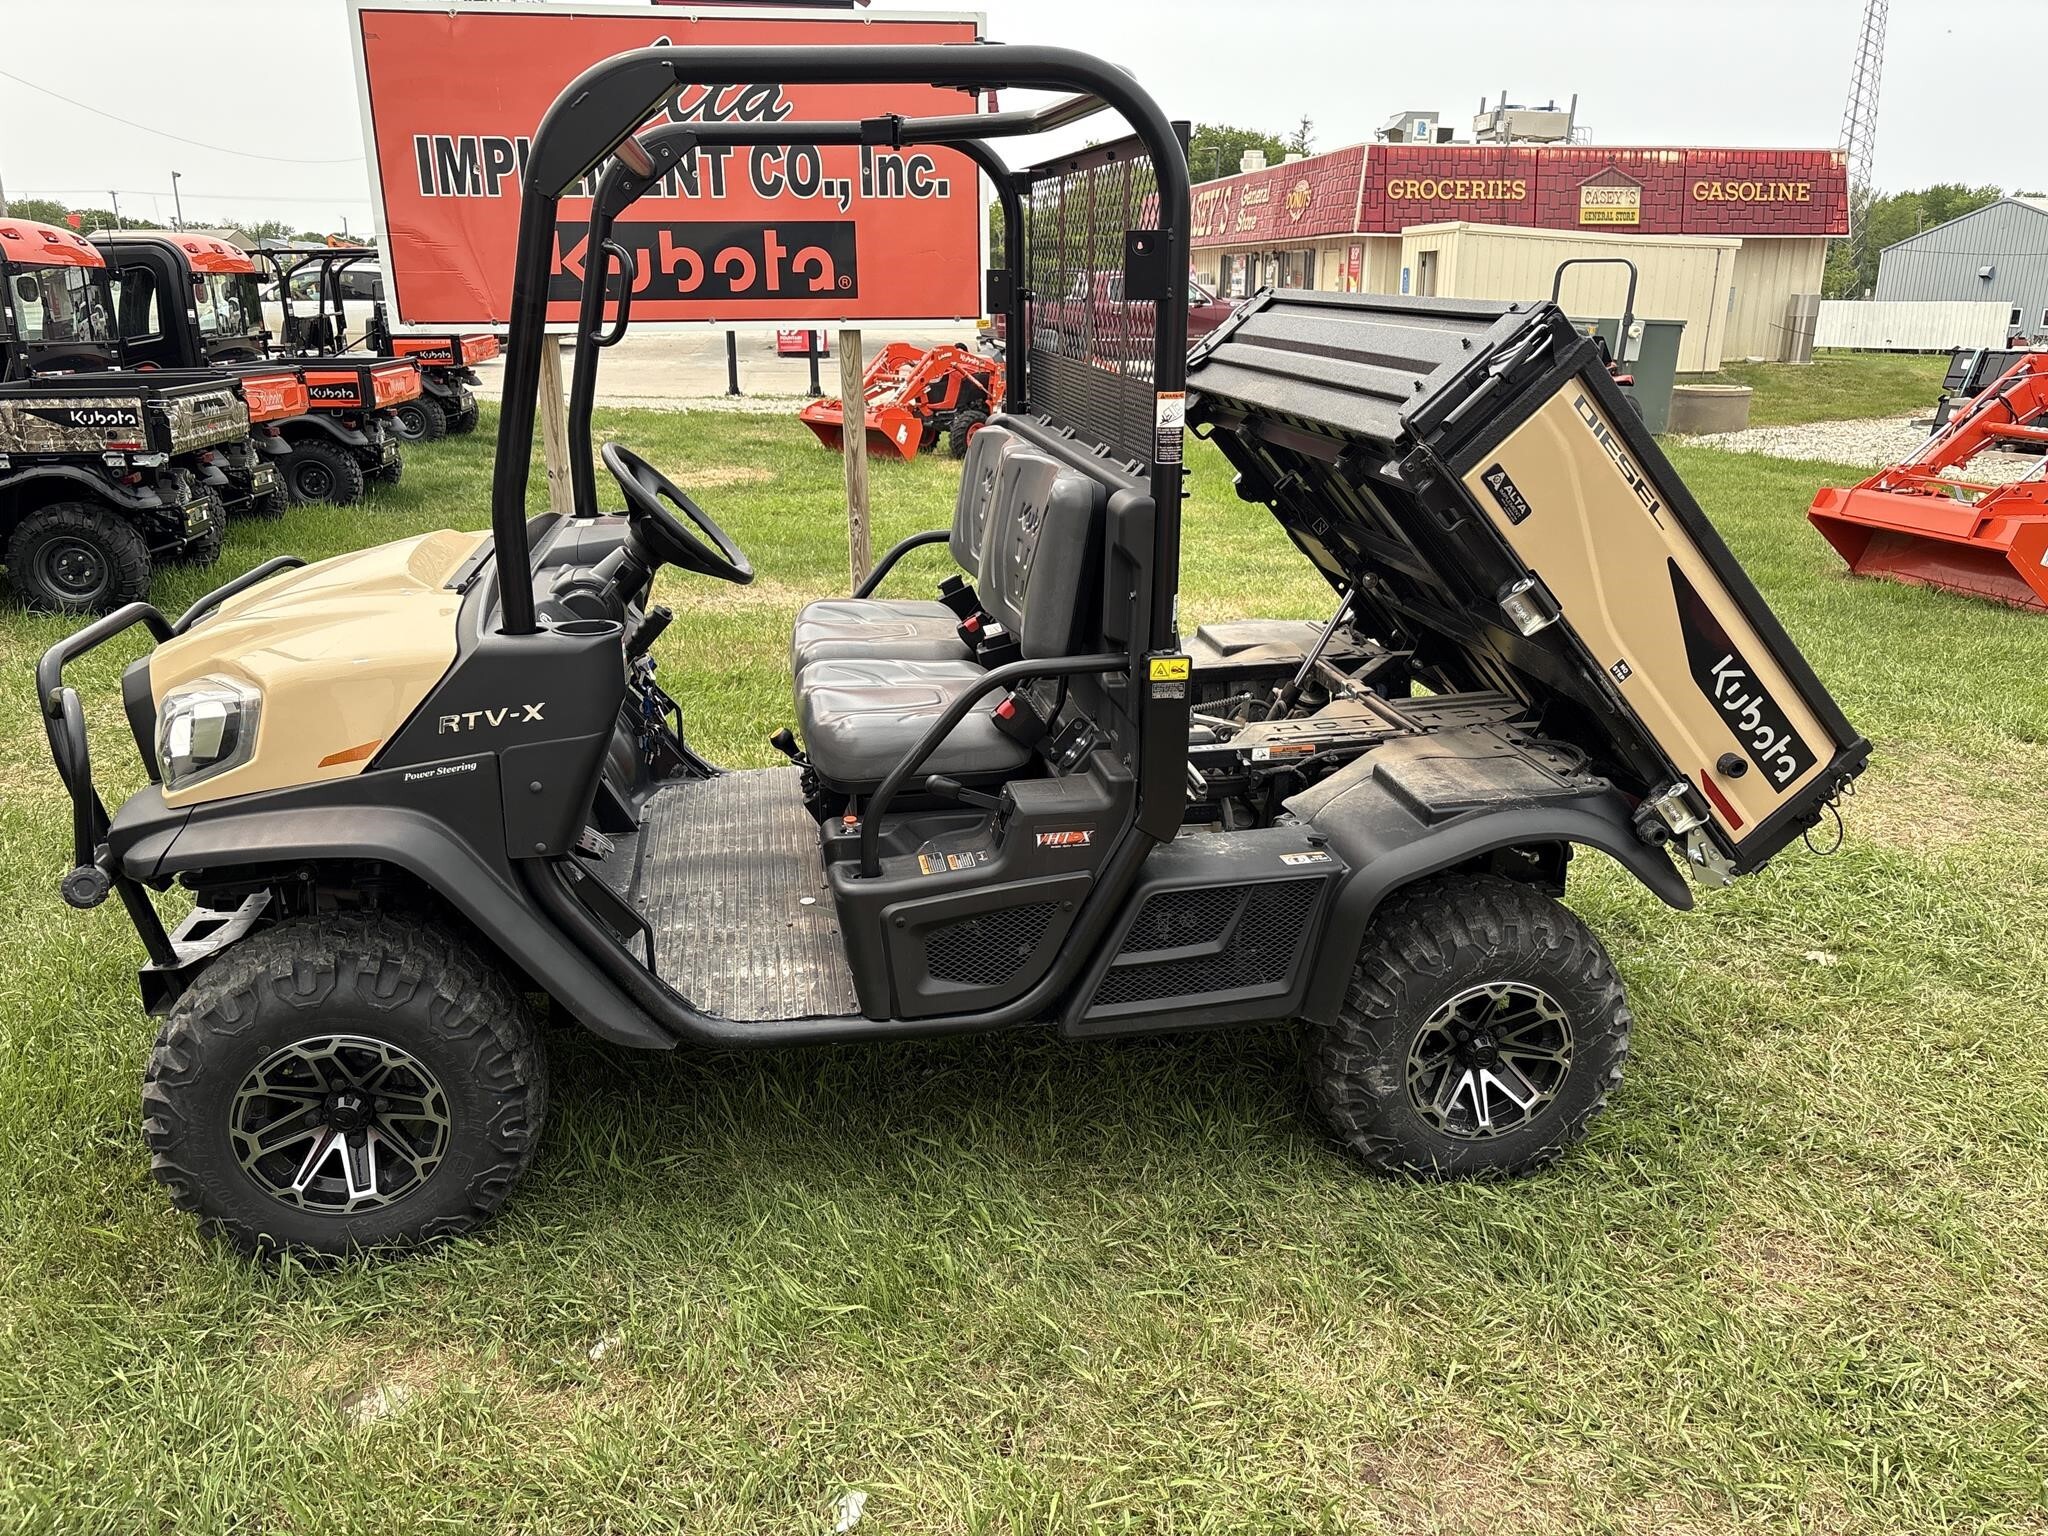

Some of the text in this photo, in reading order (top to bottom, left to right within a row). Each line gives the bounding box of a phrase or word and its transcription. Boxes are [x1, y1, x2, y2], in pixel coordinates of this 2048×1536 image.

[1240, 179, 1272, 207] General
[1285, 189, 1312, 211] DONUTS
[1387, 179, 1527, 201] GROCERIES
[1584, 190, 1637, 205] CASEY'S
[1692, 180, 1811, 202] GASOLINE
[1236, 208, 1258, 232] Store
[1584, 210, 1636, 222] GENERAL STORE
[420, 350, 451, 359] Kubota
[309, 388, 354, 399] Kubota
[70, 410, 136, 425] Kubota
[1573, 394, 1665, 531] DIESEL
[1503, 485, 1527, 515] ALTA
[1612, 665, 1625, 680] STEP
[1619, 663, 1629, 674] NO
[438, 702, 546, 735] RTV-X
[1710, 654, 1797, 783] Kubota
[404, 762, 477, 782] Power Steering
